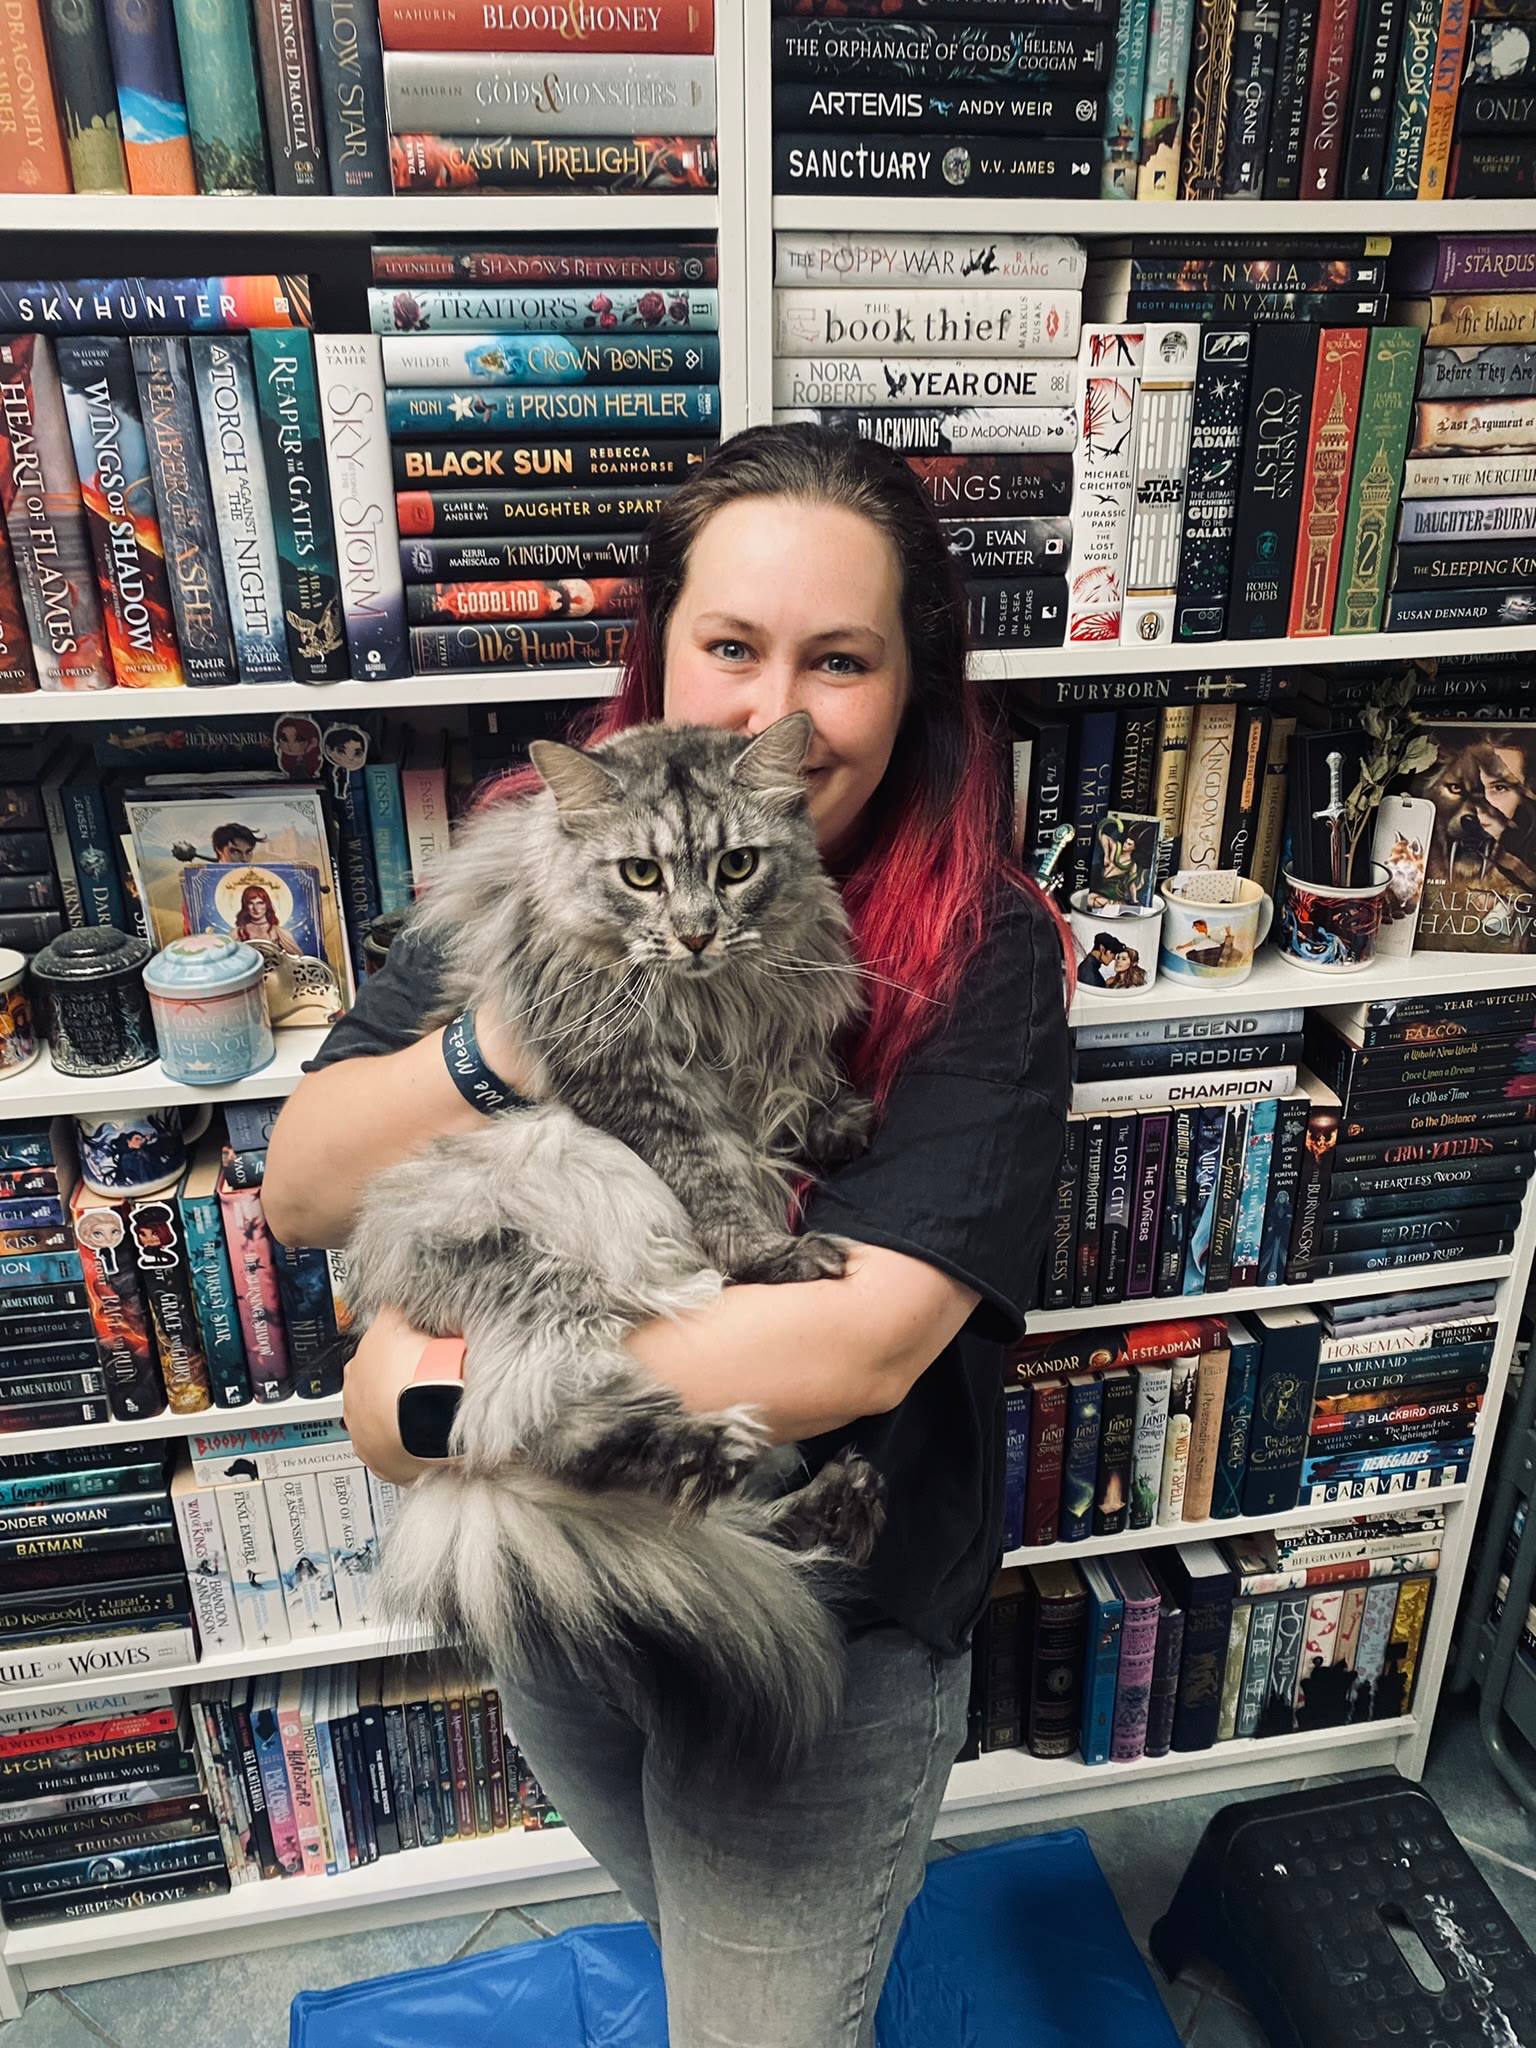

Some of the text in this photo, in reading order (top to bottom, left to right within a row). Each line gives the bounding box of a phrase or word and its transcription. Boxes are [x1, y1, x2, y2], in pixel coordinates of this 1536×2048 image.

[393, 9, 456, 22] MAHURIN
[785, 38, 1011, 62] THE ORPHANAGE OF GODS
[1023, 39, 1074, 55] HELENA
[1018, 54, 1077, 70] COGGAN
[1407, 27, 1433, 96] MOON
[5, 0, 46, 153] DRAGONFLY
[400, 86, 463, 97] MAHURIN
[287, 65, 308, 151] DRACULA
[809, 91, 923, 118] ARTEMIS
[958, 100, 1053, 117] ANDY WEIR
[1242, 82, 1263, 145] CRANE
[338, 83, 369, 167] STAR
[1286, 96, 1303, 164] THREE
[450, 140, 652, 181] CAST IN FIRELIGHT
[789, 142, 931, 180] SANCTUARY
[1010, 160, 1056, 175] JAMES
[481, 258, 570, 277] SHADOWS
[788, 249, 954, 275] THE POPPY WAR
[1002, 264, 1049, 277] KUANG
[1222, 258, 1299, 283] NYXIA
[1254, 282, 1307, 291] UNLEASHED
[18, 294, 238, 322] SKYHUNTER
[431, 297, 579, 319] TRAITOR'S
[864, 303, 890, 313] THE
[522, 320, 573, 331] KISS
[825, 307, 1012, 344] book thief
[325, 345, 367, 355] SABAA
[527, 344, 601, 374] CROWN
[326, 355, 367, 367] TAHIR
[400, 356, 450, 369] WILDER
[810, 362, 861, 383] NORA
[1436, 364, 1472, 384] Before
[792, 381, 877, 404] ROBERTS
[910, 371, 1038, 396] YEAR ONE
[409, 400, 443, 417] NONI
[521, 393, 690, 418] PRISON HEALER
[210, 366, 249, 474] TORCH
[1, 382, 45, 494] HEART
[952, 425, 1041, 438] ED McDONALD
[1253, 387, 1288, 500] QUEST
[589, 447, 651, 460] REBECCA
[404, 448, 573, 479] BLACK SUN
[590, 461, 674, 474] ROANHORSE
[1011, 476, 1041, 487] JENN
[1084, 470, 1130, 480] MICHAEL
[1079, 481, 1132, 491] CRICHTON
[1139, 478, 1184, 492] STAR
[1006, 490, 1044, 500] LYONS
[1137, 490, 1183, 505] WARS
[27, 497, 47, 523] OF
[227, 491, 244, 521] THE
[238, 477, 258, 536] AGAINST
[443, 503, 473, 513] CLAIRE
[504, 500, 612, 518] DAUGHTER OF
[1081, 508, 1127, 519] JURASSIC
[1188, 506, 1235, 520] GUIDE
[85, 378, 125, 489] WINGS
[109, 519, 155, 655] SHADOW
[287, 475, 316, 557] GATES
[444, 511, 489, 522] ANDREWS
[1091, 520, 1117, 529] PARK
[1414, 510, 1483, 535] DAUGHTER
[986, 529, 1027, 546] EVAN
[1090, 541, 1114, 551] LOST
[1096, 533, 1110, 541] THE
[338, 497, 389, 620] STORM
[449, 556, 500, 568] MANISCALCO
[461, 549, 487, 559] KERRI
[502, 544, 585, 570] KINGDOM
[971, 550, 1035, 567] WINTER
[1083, 552, 1119, 562] WORLD
[1413, 558, 1507, 579] THE SLEEPING
[30, 526, 78, 657] FLAMES
[234, 538, 271, 638] NIGHT
[1245, 591, 1278, 602] HOBB
[1246, 582, 1279, 593] ROBIN
[457, 590, 540, 615] GODBLIND
[1397, 606, 1488, 621] SUSAN DENNARD
[188, 658, 227, 670] TAHIR
[245, 651, 281, 666] TAHIR
[1057, 679, 1172, 704] FURYBORN
[1443, 680, 1488, 697] BOYS
[1120, 720, 1143, 801] SCHWAB
[1095, 1030, 1151, 1041] MARIE LU
[1163, 1017, 1259, 1040] LEGEND
[1102, 1057, 1154, 1069] MARIE LU
[1169, 1046, 1270, 1069] PRODIGY
[1101, 1093, 1153, 1105] MARIE LU
[1168, 1079, 1273, 1102] CHAMPION
[1109, 1146, 1129, 1219] LOST CITY
[1373, 1174, 1432, 1191] HEARTLESS
[1139, 1163, 1158, 1242] THE DIVINERS
[4, 1235, 38, 1249] KISS
[1434, 1325, 1483, 1339] CHRISTINA
[1442, 1334, 1473, 1345] HENRY
[1139, 1337, 1202, 1360] STEADMAN
[1328, 1337, 1416, 1360] HORSEMAN
[1016, 1354, 1080, 1380] SKANDAR
[1346, 1356, 1408, 1374] MERMAID
[10, 1380, 73, 1397] ARMENTROUT
[1347, 1373, 1408, 1391] LOST BOY
[1367, 1402, 1460, 1424] BLACKBIRD GIRLS
[301, 1428, 329, 1439] EAMES
[1392, 1428, 1440, 1442] Nightingale
[1402, 1423, 1420, 1432] Bear
[194, 1432, 246, 1457] BLOODY
[298, 1449, 358, 1467] MAGICIANS
[1360, 1449, 1432, 1473] RENEGADES
[1325, 1476, 1415, 1501] CARAVAL
[51, 1508, 109, 1525] WOMAN
[233, 1491, 257, 1566] FINAL EMPIRE
[286, 1500, 305, 1556] ASCENSION
[16, 1537, 84, 1557] BATMAN
[99, 1603, 152, 1618] BARDUGO
[108, 1597, 140, 1609] LEIGH
[194, 1576, 217, 1636] SANDERSON
[208, 1579, 230, 1629] BRANDON
[21, 1606, 83, 1626] KINGDOM
[47, 1646, 151, 1679] OF WOLVES
[85, 1740, 158, 1762] HUNTER
[37, 1763, 161, 1791] THESE REBEL WAVES
